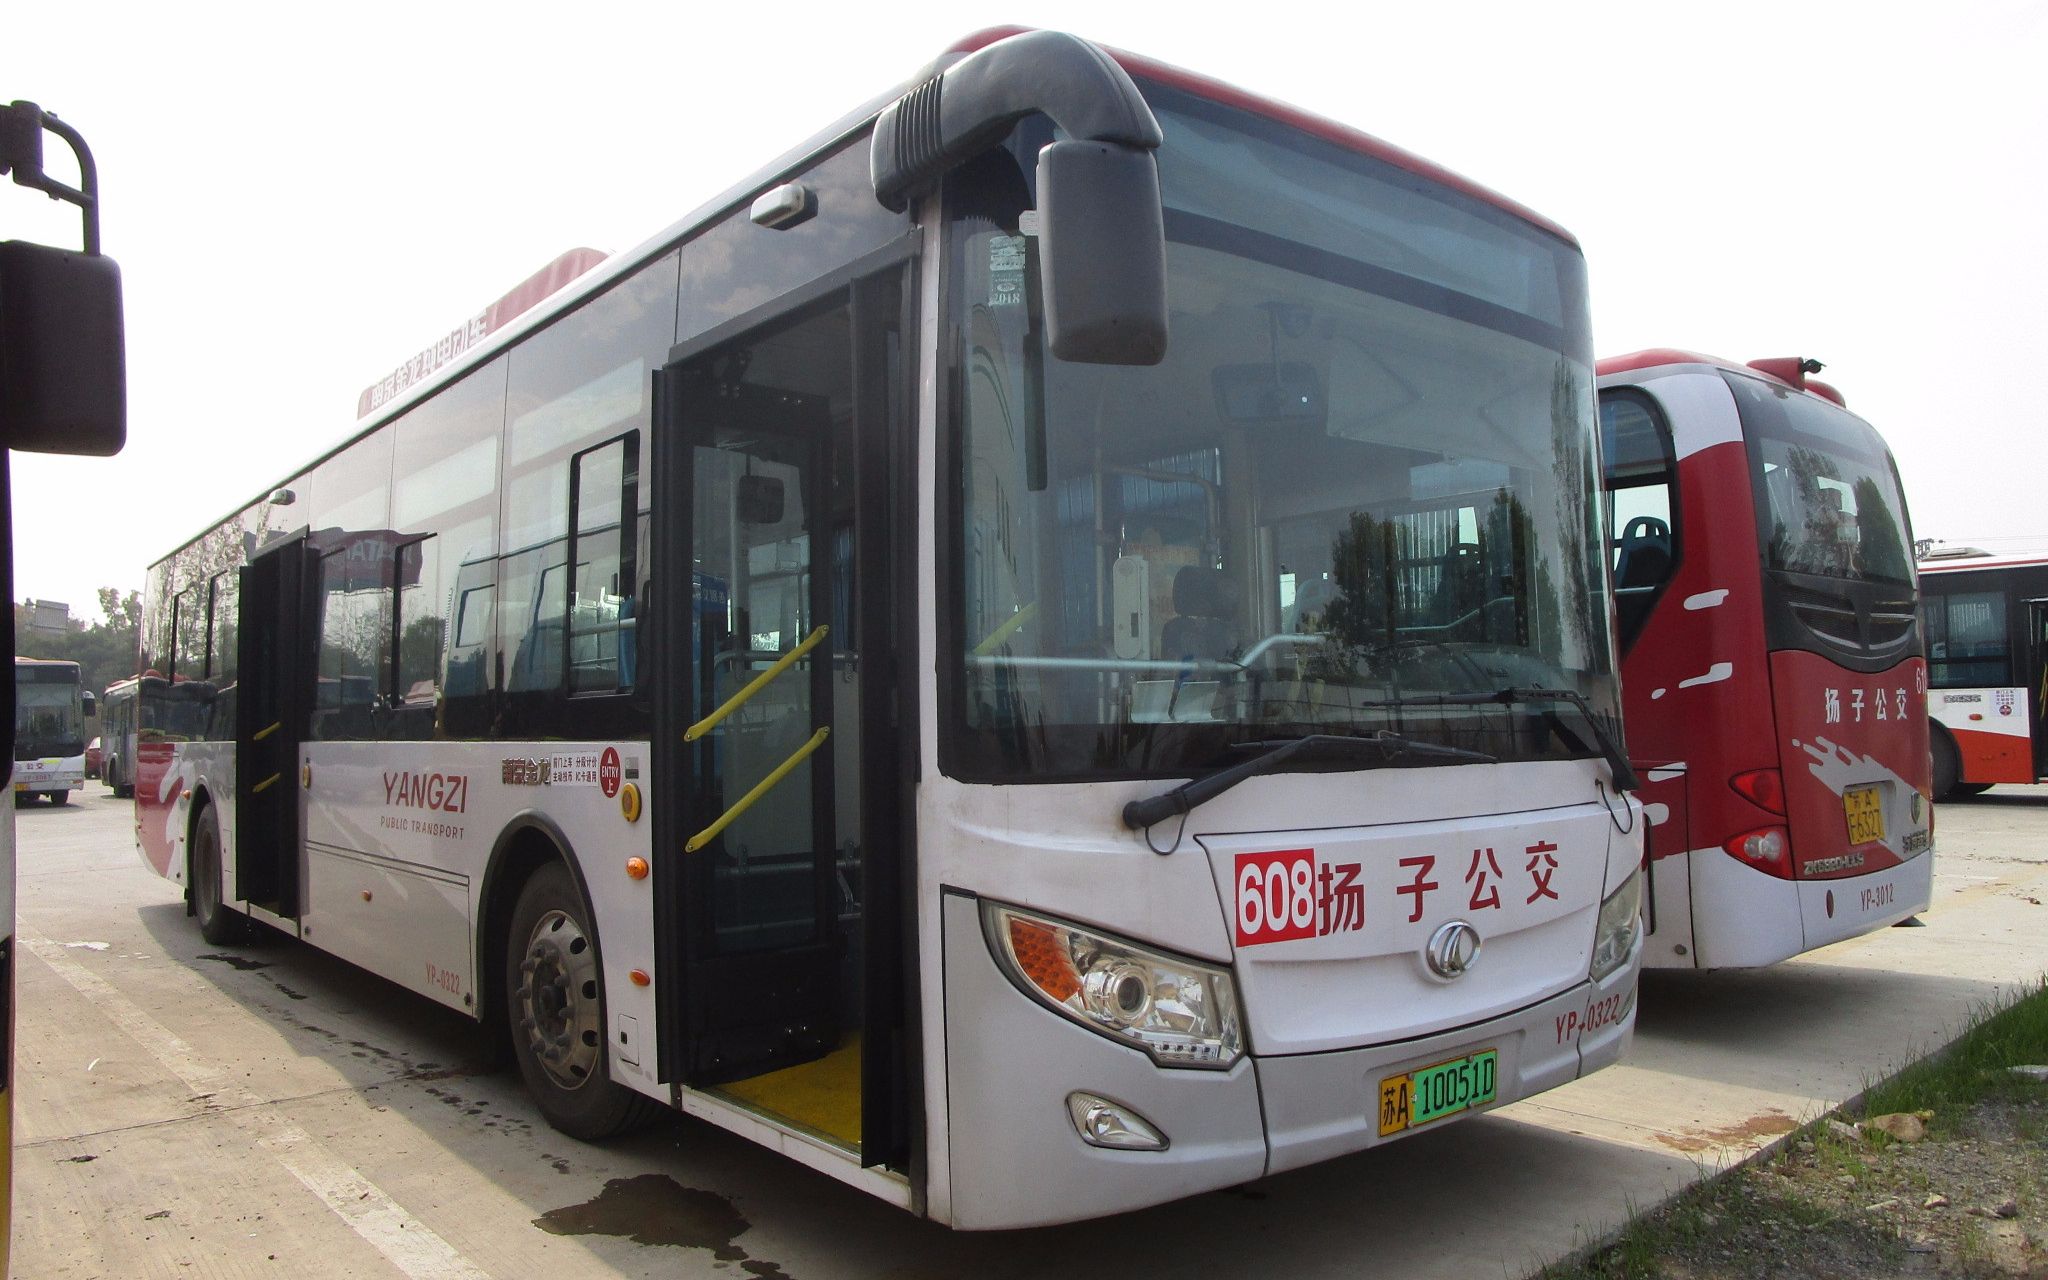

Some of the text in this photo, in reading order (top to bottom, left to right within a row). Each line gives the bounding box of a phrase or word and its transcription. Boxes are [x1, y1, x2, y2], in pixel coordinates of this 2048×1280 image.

[992, 293, 1020, 304] 2018
[1825, 687, 1908, 724] 扬子公交
[601, 765, 619, 778] ENTRY
[606, 780, 614, 793] 上
[383, 771, 467, 813] YANGZI
[380, 816, 465, 840] PUBLIC TRANSPORT
[1238, 840, 1559, 937] 608 扬子公交
[1860, 882, 1894, 911] YP-3012
[425, 961, 460, 995] YP-0322
[1556, 993, 1621, 1044] YP-0322
[1383, 1058, 1495, 1127] 苏A 10051D
